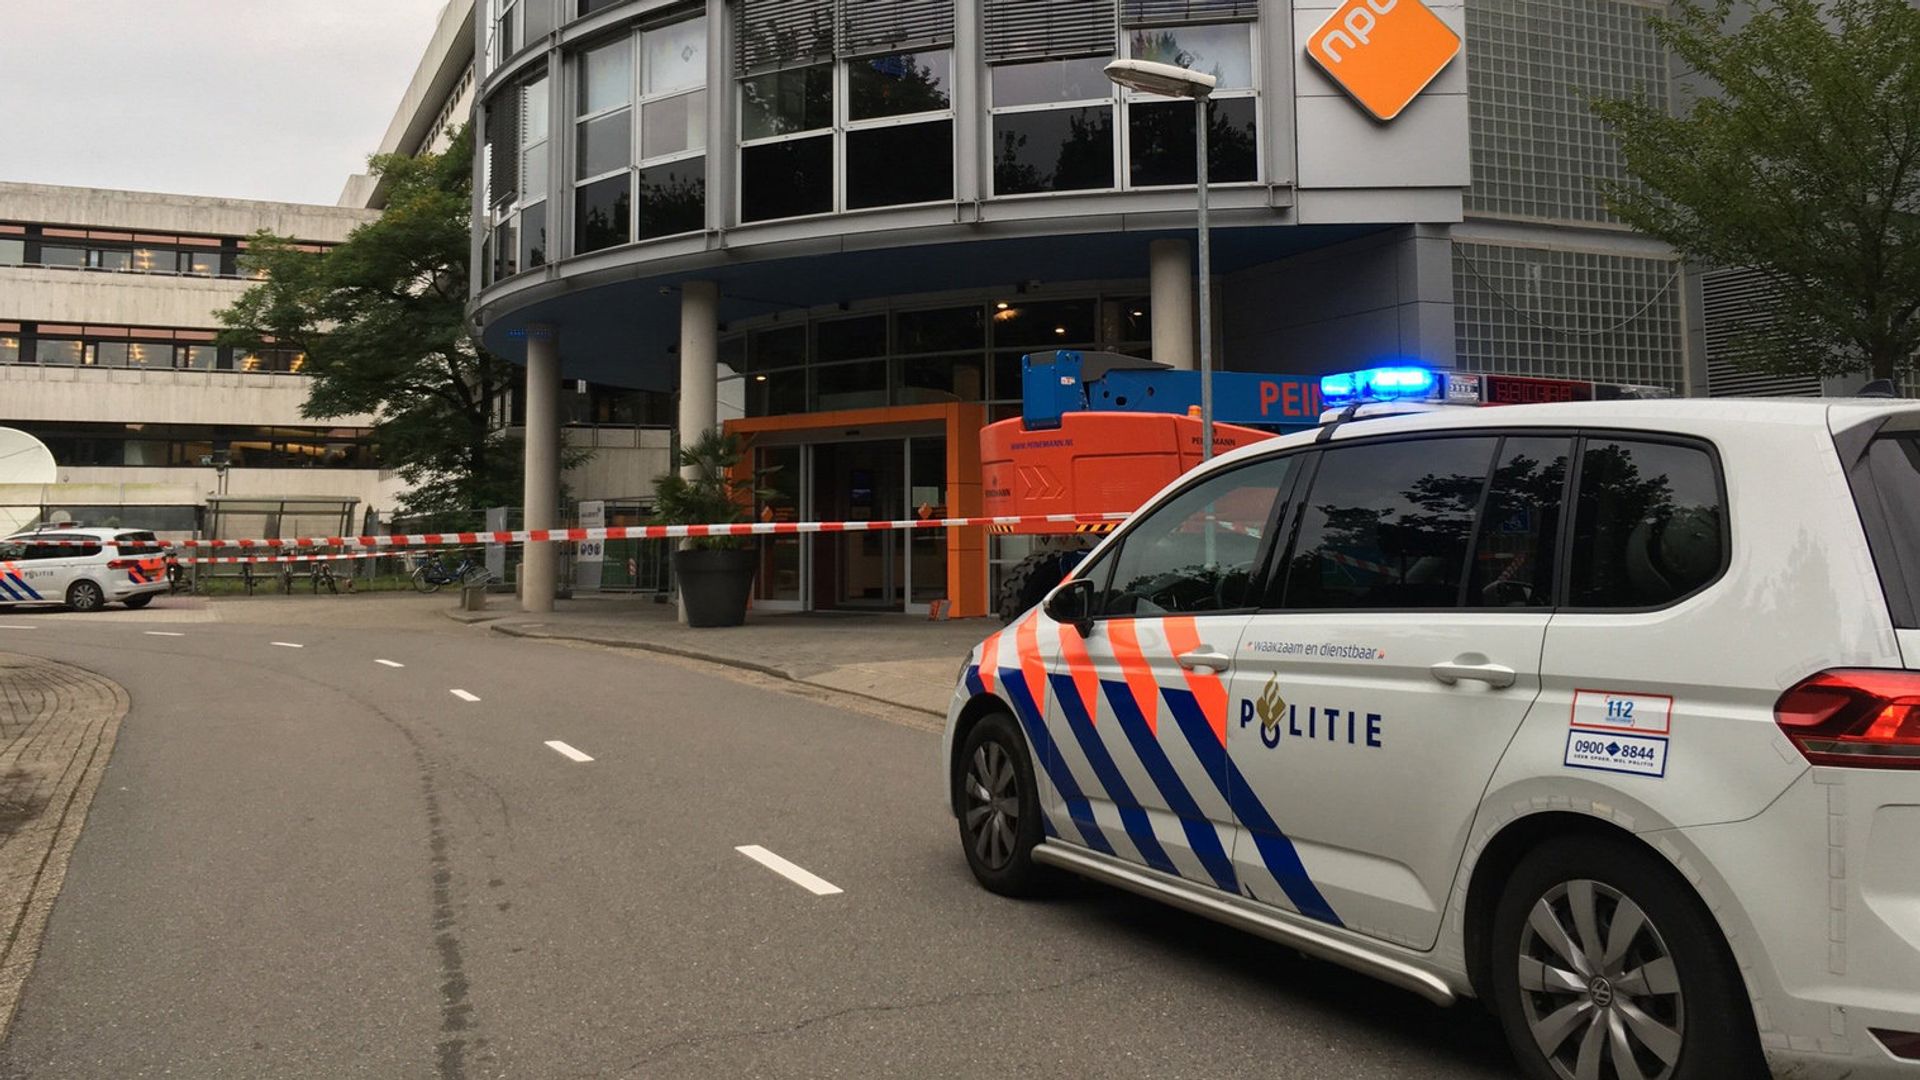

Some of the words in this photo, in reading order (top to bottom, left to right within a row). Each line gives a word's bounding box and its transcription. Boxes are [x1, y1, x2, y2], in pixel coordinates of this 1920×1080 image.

[1254, 641, 1304, 653] waakzaam
[1305, 644, 1318, 655] en
[1320, 643, 1377, 659] dienstbaar
[1240, 698, 1382, 749] POLITIE
[1575, 740, 1604, 754] 0900
[1621, 744, 1654, 760] 8844
